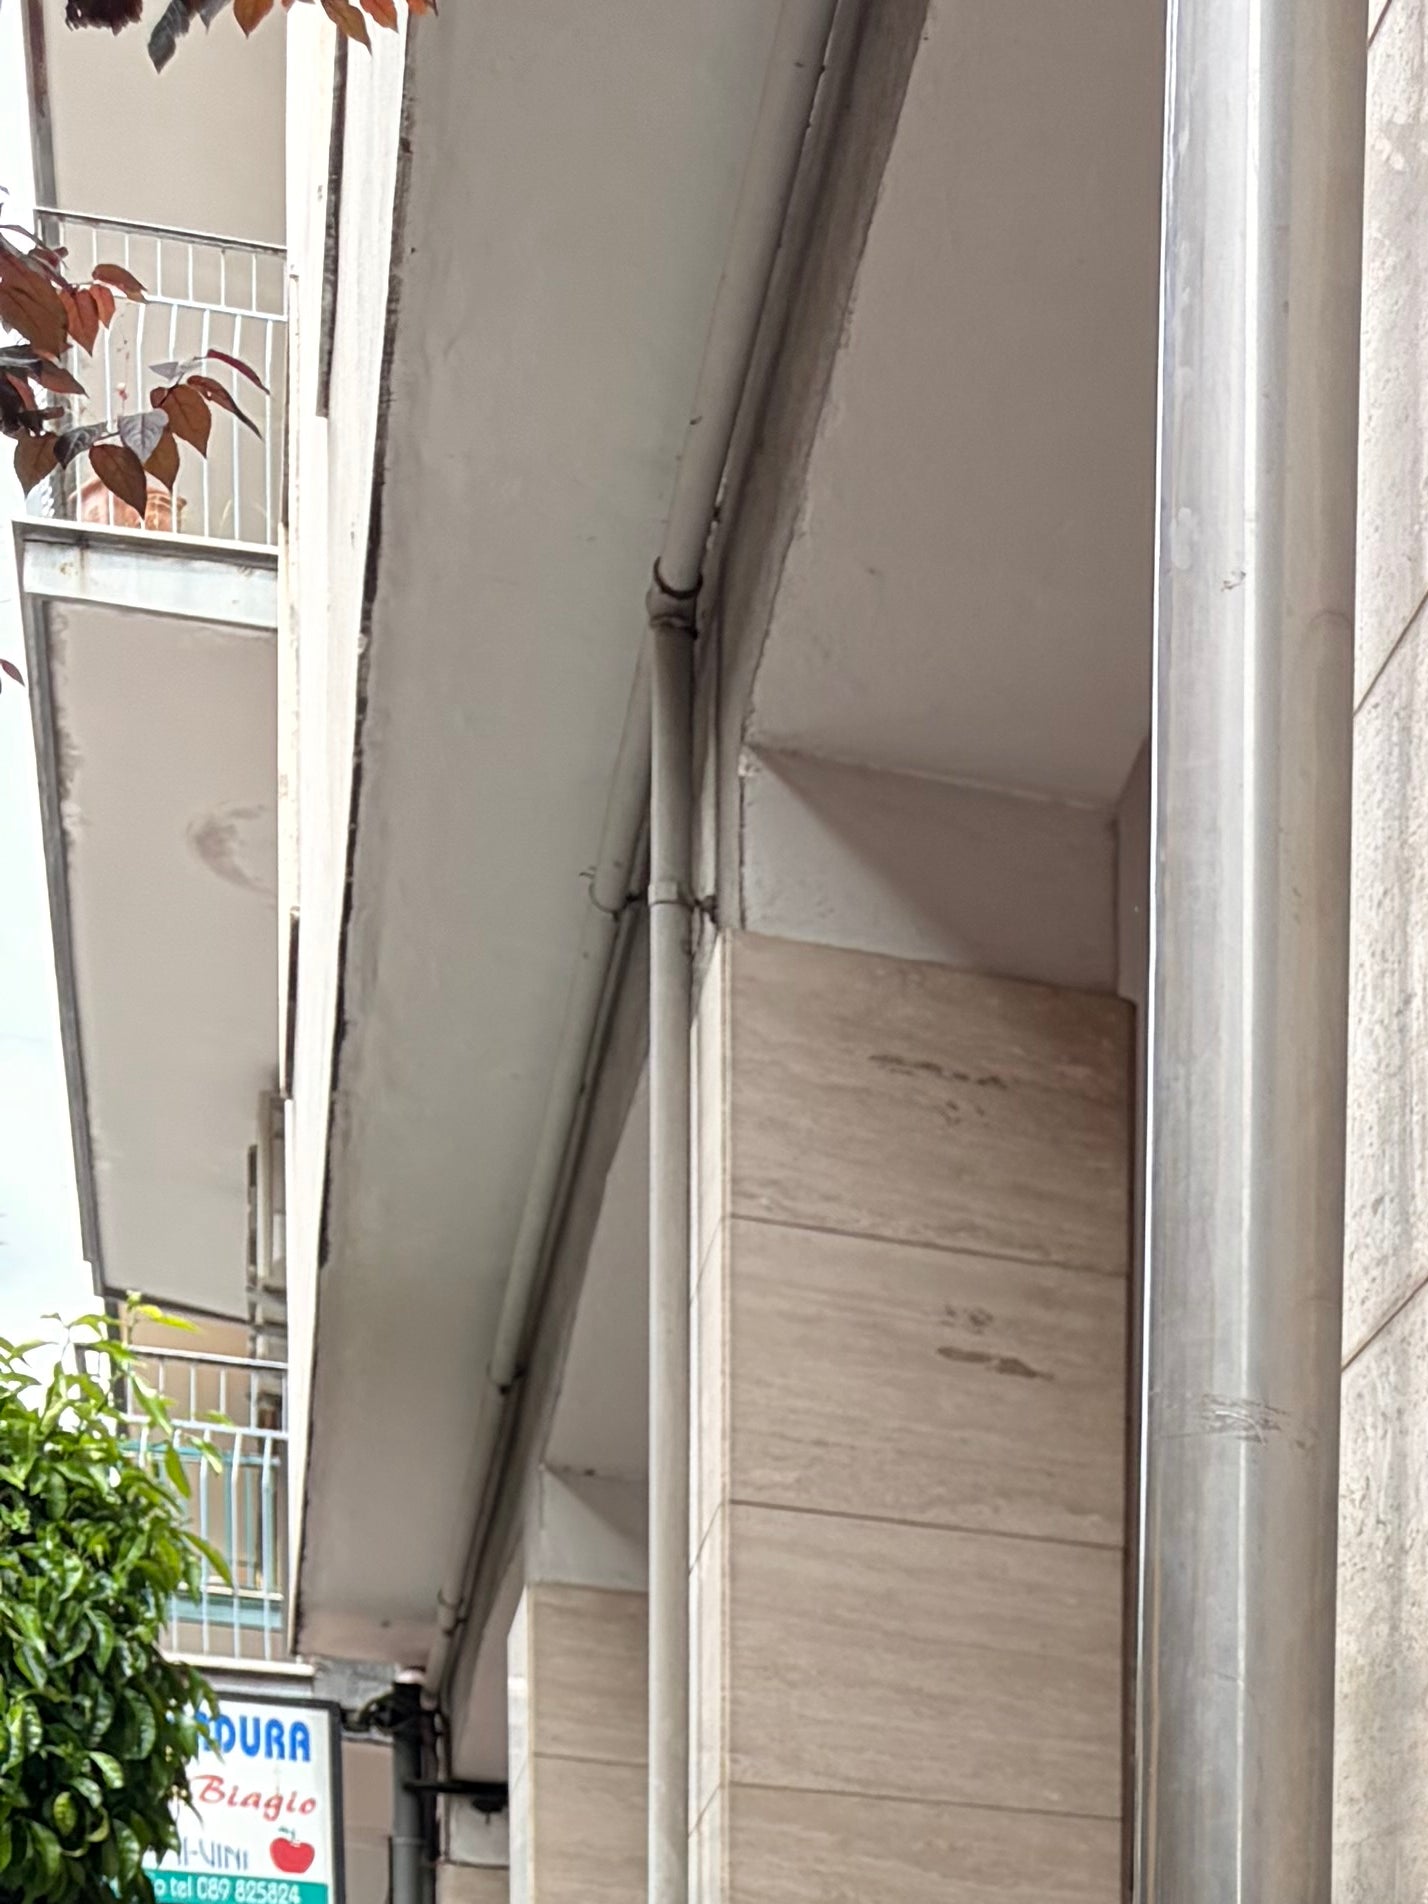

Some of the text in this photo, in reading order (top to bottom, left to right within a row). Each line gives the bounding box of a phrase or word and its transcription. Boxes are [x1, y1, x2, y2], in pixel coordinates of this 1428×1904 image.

[191, 1774, 317, 1822] Biagio
[170, 1875, 192, 1899] tel
[196, 1876, 231, 1902] 089
